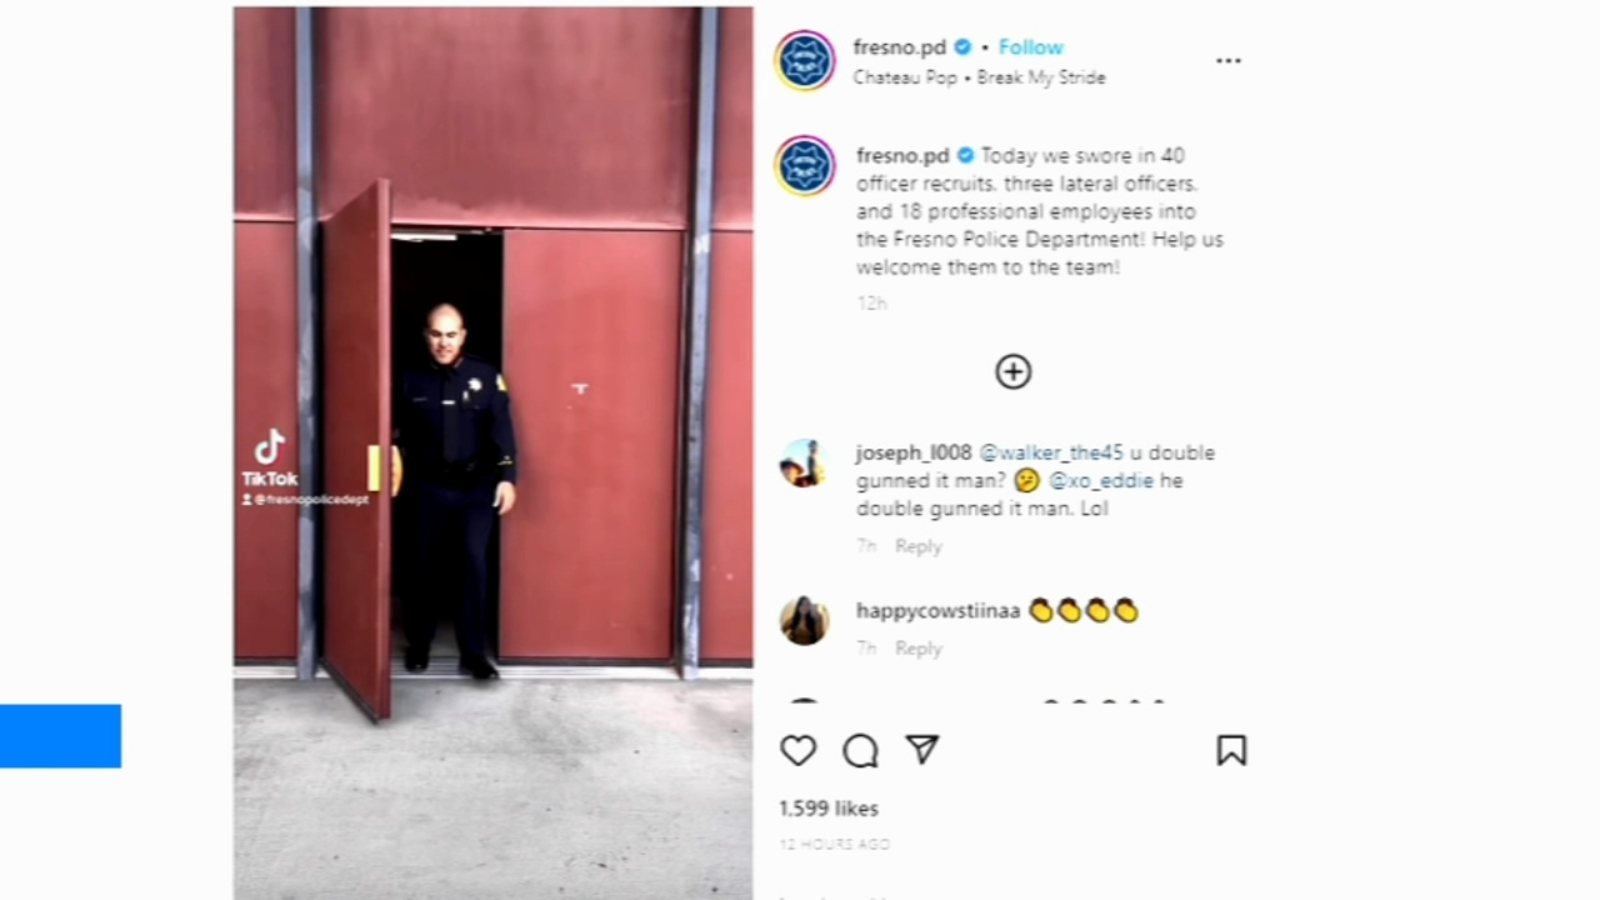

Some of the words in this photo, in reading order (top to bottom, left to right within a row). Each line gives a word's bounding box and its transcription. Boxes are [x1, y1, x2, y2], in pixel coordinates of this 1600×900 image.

[853, 37, 947, 60] fresno.pd
[998, 37, 1065, 57] Follow
[853, 68, 921, 85] Chateau
[926, 69, 958, 88] Pop
[977, 68, 1023, 85] Break
[1029, 69, 1053, 89] My
[1059, 68, 1106, 85] Stride
[856, 146, 950, 168] fresno.pd
[981, 147, 1037, 169] Today
[1042, 151, 1070, 165] we
[1075, 151, 1132, 165] swore
[1138, 147, 1155, 165] in
[1160, 147, 1186, 165] 40
[856, 174, 918, 193] officer
[1003, 174, 1054, 193] three
[1060, 174, 1118, 193] lateral
[856, 203, 893, 221] and
[900, 202, 922, 221] 18
[928, 202, 1043, 223] professional
[1049, 203, 1153, 224] employees
[1158, 203, 1197, 221] into
[856, 230, 888, 249] the
[894, 230, 957, 249] Fresno
[964, 230, 1019, 249] Police
[1026, 230, 1146, 251] Department!
[1153, 230, 1197, 251] Help
[1202, 234, 1225, 249] us
[856, 259, 942, 276] welcome
[947, 259, 997, 276] them
[1002, 261, 1022, 276] to
[1028, 259, 1060, 276] the
[1066, 259, 1120, 276] team!
[858, 295, 888, 311] 12h
[979, 443, 1124, 465] @walker_the45
[1130, 447, 1143, 461] u
[1148, 444, 1216, 461] double
[856, 472, 931, 494] gunned
[936, 471, 950, 489] it
[955, 471, 1006, 489] man?
[1049, 471, 1155, 492] @xo_eddie
[1159, 471, 1184, 489] he
[856, 499, 924, 517] double
[929, 500, 1003, 522] gunned
[1009, 499, 1022, 517] it
[1028, 503, 1075, 517] man.
[1080, 500, 1109, 517] Lol
[896, 537, 943, 558] Reply
[856, 601, 1021, 624] happycowstiinaa
[896, 639, 943, 660] Reply
[835, 799, 880, 817] likes
[779, 838, 796, 851] 12
[801, 838, 854, 851] HOURS
[859, 838, 890, 851] AGO
